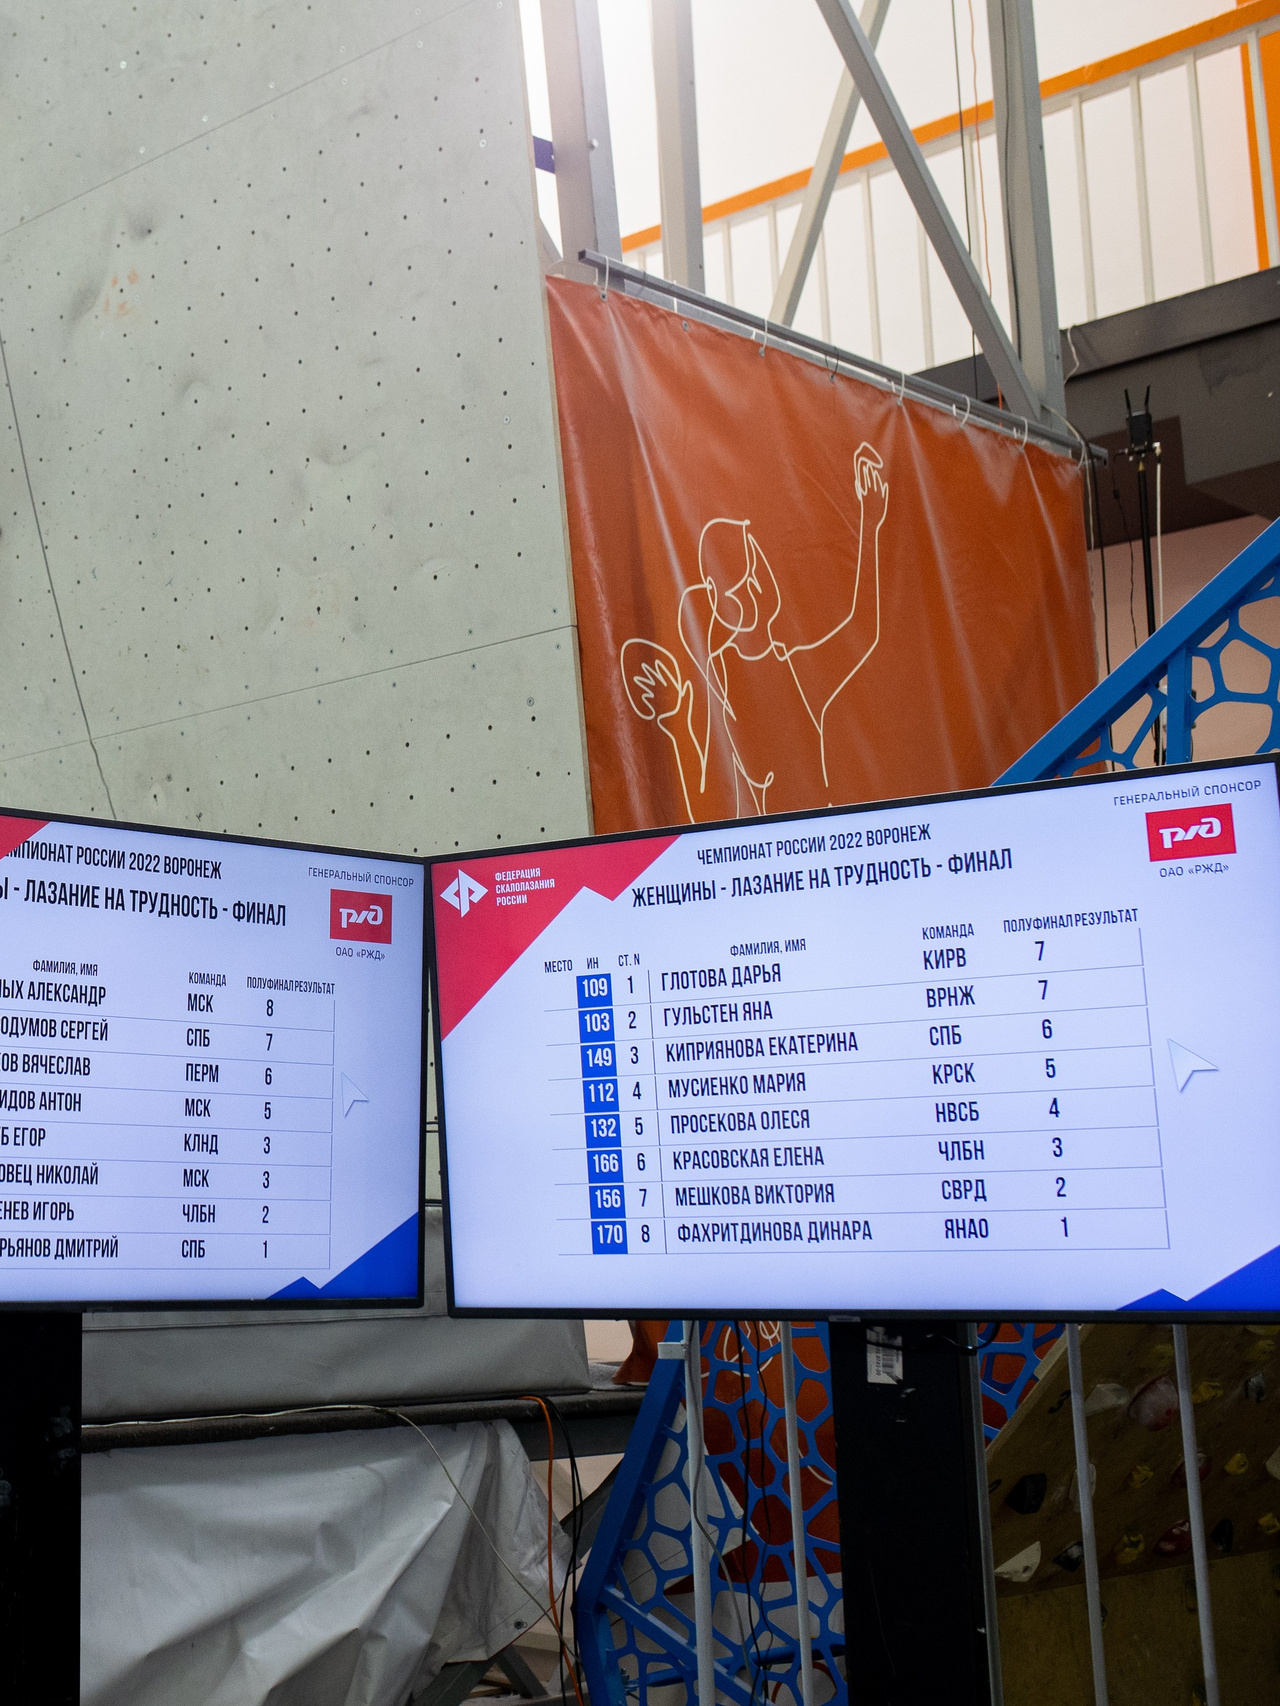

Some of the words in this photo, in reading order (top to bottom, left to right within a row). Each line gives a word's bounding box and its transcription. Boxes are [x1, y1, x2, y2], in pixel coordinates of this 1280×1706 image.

[1113, 785, 1200, 806] ГЕНЕРАЛЬНЫЙ
[1204, 780, 1261, 795] СПОНСОР
[698, 842, 772, 865] ЧЕМПИОНАТ
[777, 836, 825, 856] РОССИИ
[830, 832, 862, 850] 2022
[867, 824, 931, 846] ВОРОНЕЖ
[77, 846, 125, 869] РОССИИ
[129, 852, 160, 873] 2022
[164, 856, 221, 879] ВОРОНЕЖ
[495, 867, 541, 881] ФЕДЕРАЦИЯ
[1160, 867, 1183, 877] ОАО
[1189, 863, 1229, 874] «РЖД»
[309, 867, 371, 882] ГЕНЕРАЛЬНЫЙ
[375, 875, 414, 887] СПОНСОР
[495, 878, 555, 894] СКАЛОЛАЗАНИЯ
[632, 880, 717, 907] ЖЕНЩИНЫ
[732, 871, 804, 897] ЛАЗАНИЕ
[809, 868, 831, 889] НА
[834, 858, 931, 886] ТРУДНОСТЬ
[948, 848, 1012, 874] ФИНАЛ
[24, 879, 100, 908] ЛАЗАНИЕ
[105, 887, 125, 911] НА
[130, 890, 217, 919] ТРУДНОСТЬ
[233, 901, 285, 926] ФИНАЛ
[497, 894, 527, 906] РОССИИ
[336, 947, 353, 957] ОАО
[357, 949, 385, 961] «РЖД»
[545, 960, 572, 973] МЕСТО
[587, 957, 599, 969] ИН
[619, 954, 631, 966] СТ.
[730, 941, 782, 956] ФАМИЛИЯ,
[785, 939, 806, 952] ИМЯ
[922, 924, 974, 940] КОМАНДА
[1004, 914, 1073, 933] ПОЛУФИНАЛ
[1075, 908, 1138, 926] РЕЗУЛЬТАТ
[33, 960, 77, 974] ФАМИЛИЯ,
[81, 963, 97, 976] ИМЯ
[189, 972, 226, 987] КОМАНДА
[247, 977, 293, 991] ПОЛУФИНАЛ
[295, 981, 335, 994] РЕЗУЛЬТАТ
[583, 978, 608, 997] 109
[662, 968, 727, 991] ГЛОТОВА
[732, 963, 781, 988] ДАРЬЯ
[923, 948, 966, 970] КИРВ
[28, 981, 106, 1007] АЛЕКСАНДР
[188, 993, 213, 1012] МСК
[585, 1013, 610, 1032] 103
[664, 1003, 738, 1026] ГУЛЬСТЕН
[743, 1001, 773, 1021] ЯНА
[927, 985, 975, 1008] ВРНЖ
[61, 1019, 108, 1041] СЕРГЕЙ
[187, 1028, 210, 1047] СПБ
[23, 1054, 90, 1076] ВЯЧЕСЛАВ
[186, 1063, 218, 1082] ПЕРМ
[39, 1092, 81, 1111] АНТОН
[185, 1098, 211, 1117] МСК
[14, 1127, 45, 1147] ЕГОР
[184, 1134, 218, 1155] КЛНД
[37, 1162, 98, 1185] НИКОЛАЙ
[184, 1169, 209, 1187] МСК
[33, 1202, 74, 1220] ИГОРЬ
[183, 1204, 215, 1222] ЧЛБН
[597, 1225, 623, 1244] 170
[678, 1222, 803, 1244] ФАХРИТДИНОВА
[808, 1221, 872, 1243] ДИНАРА
[945, 1219, 989, 1238] ЯНАО
[54, 1235, 118, 1260] ДМИТРИЙ
[182, 1240, 205, 1258] СПБ
